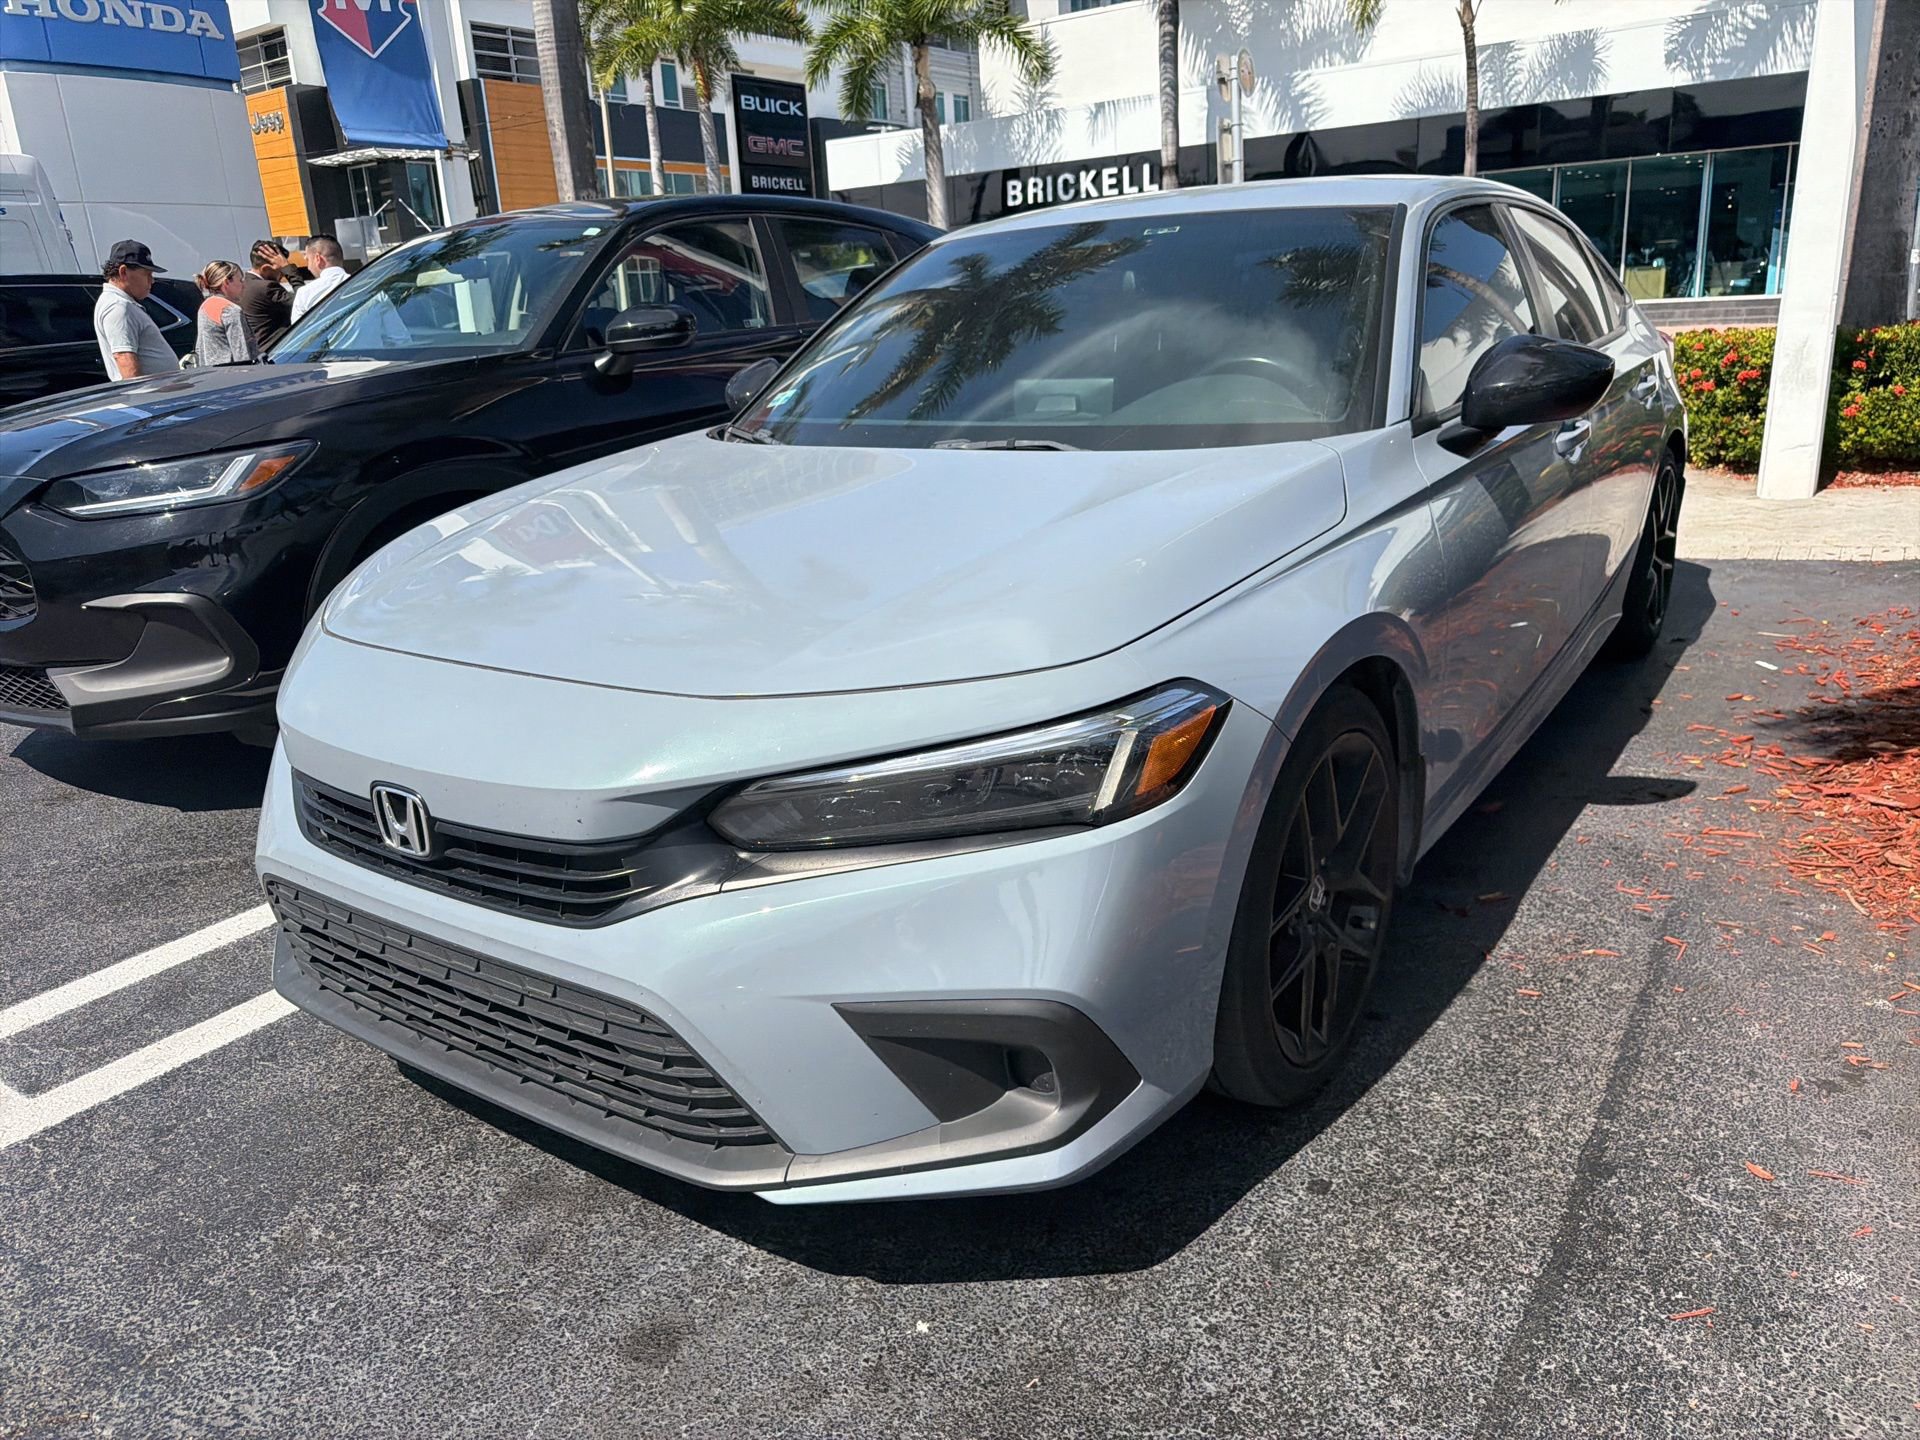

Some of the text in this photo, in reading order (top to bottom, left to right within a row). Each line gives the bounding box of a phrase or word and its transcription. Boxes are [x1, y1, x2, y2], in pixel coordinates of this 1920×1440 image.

[740, 94, 804, 117] BUICK
[251, 111, 284, 134] Jeep
[748, 135, 805, 157] GMC
[751, 175, 807, 191] BRICKELL
[1006, 162, 1160, 207] BRICKELL
